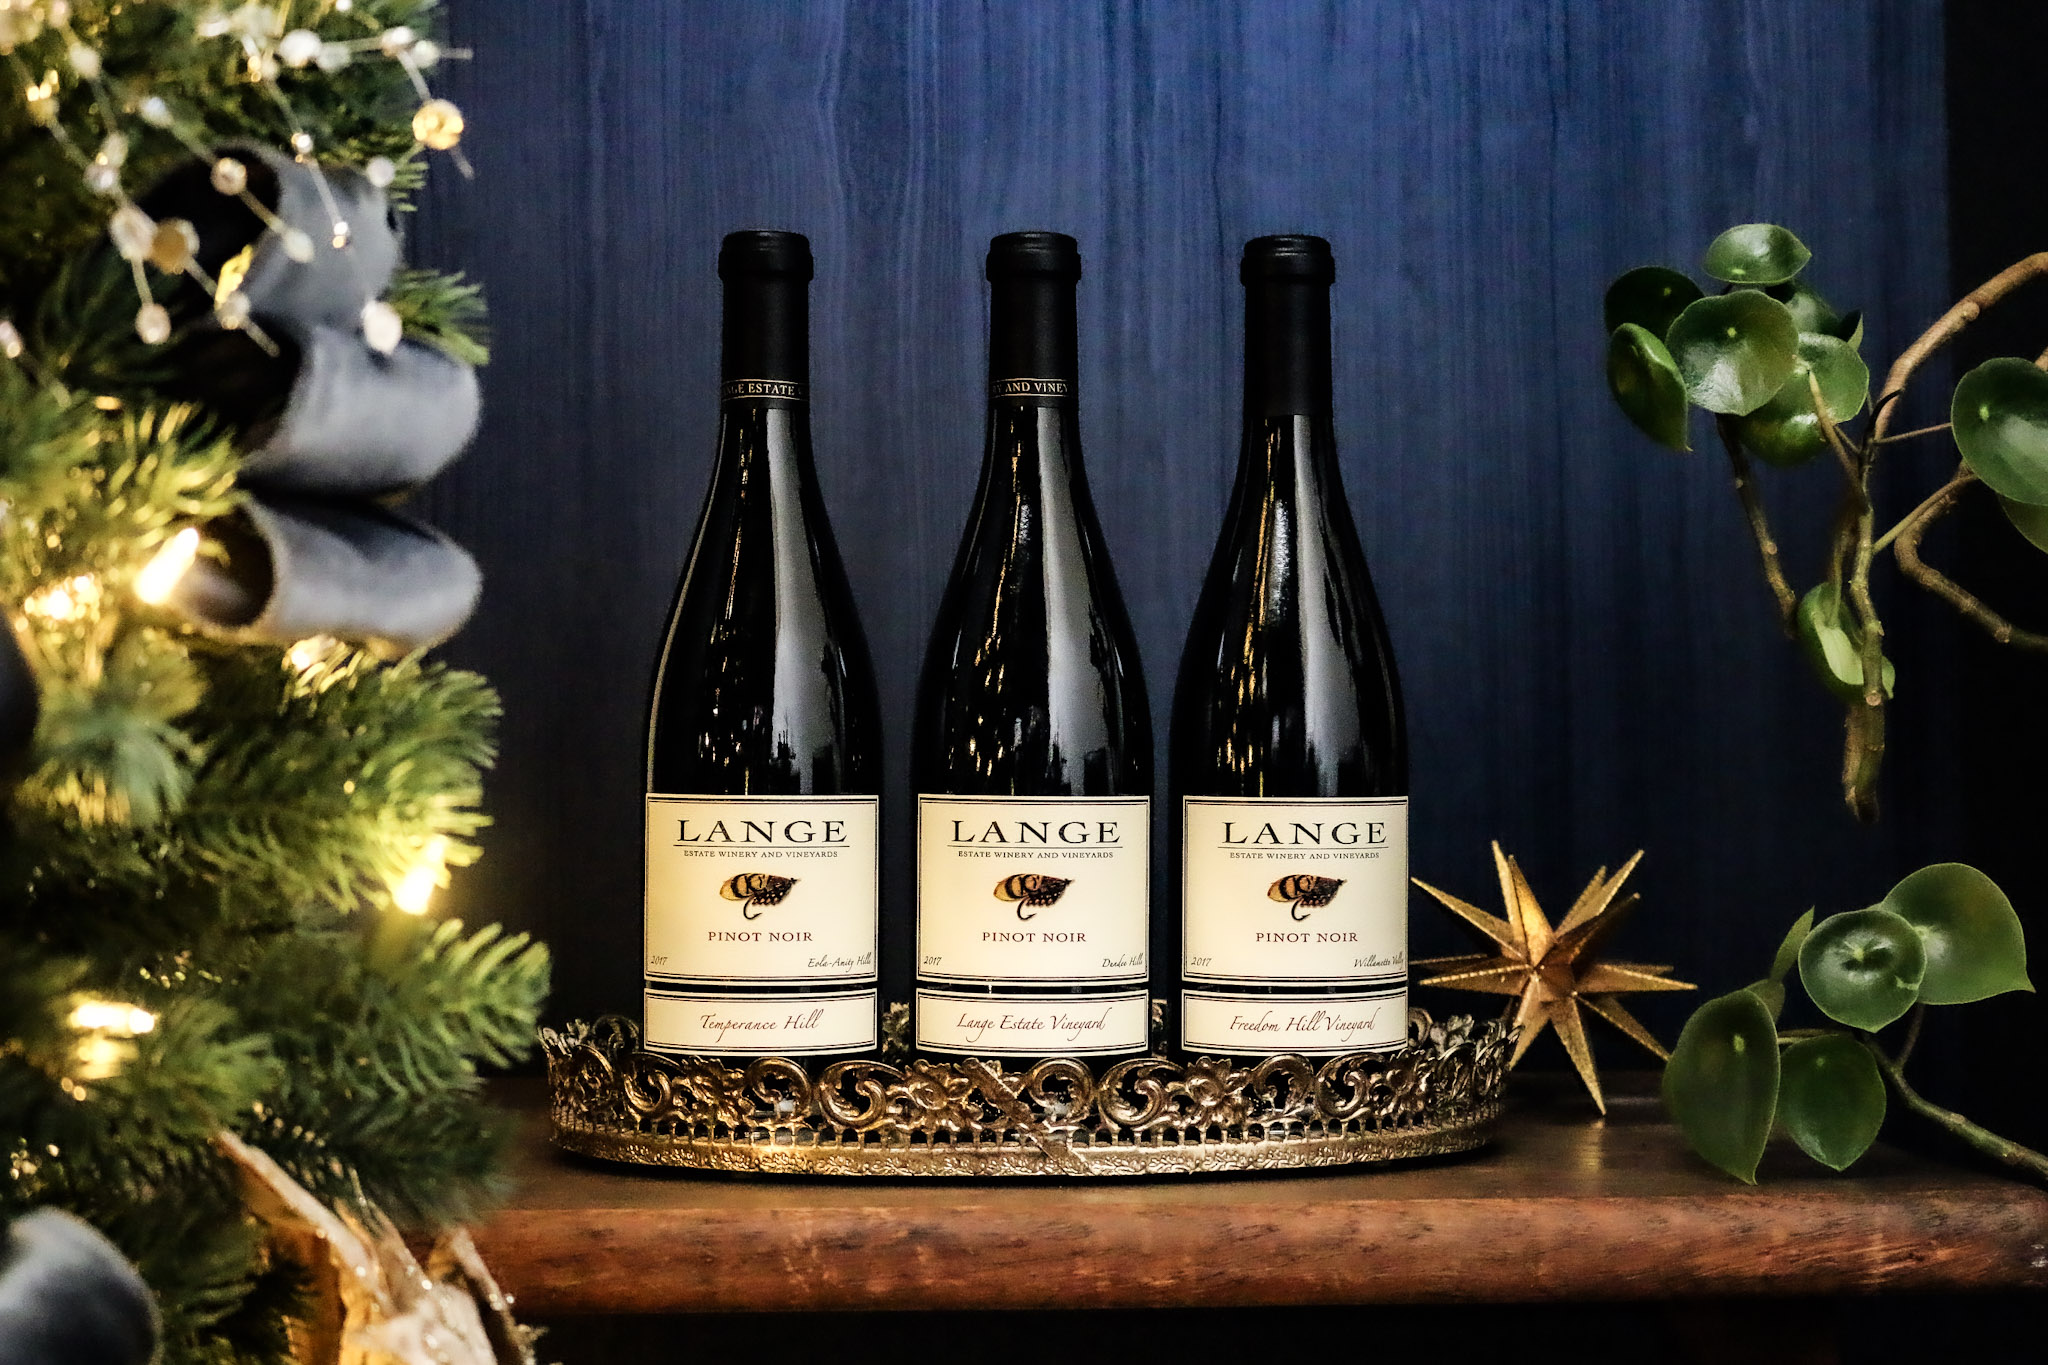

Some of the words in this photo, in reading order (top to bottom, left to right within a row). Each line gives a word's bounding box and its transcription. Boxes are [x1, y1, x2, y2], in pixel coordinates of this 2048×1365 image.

[748, 383, 795, 396] ESTATE
[1005, 381, 1031, 393] AND
[677, 819, 848, 844] LANGE
[951, 820, 1121, 844] LANGE
[1221, 821, 1388, 845] LANGE
[683, 850, 716, 858] ESTATE
[958, 850, 991, 858] ESTATE
[994, 851, 1033, 859] WINERY
[1037, 851, 1059, 859] AND
[1061, 851, 1114, 859] VINEYARDS
[1266, 852, 1306, 860] WINERY
[1309, 852, 1331, 860] AND
[708, 931, 762, 942] PINOT
[769, 932, 814, 942] NOIR
[982, 932, 1036, 942] PINOT
[1042, 932, 1087, 942] NOIR
[1256, 932, 1311, 943] PINOT
[1317, 932, 1359, 943] NOIR
[650, 955, 668, 966] 2017
[923, 955, 942, 966] 2017
[1190, 956, 1212, 967] 2017
[699, 1013, 777, 1043] Temperance
[783, 1008, 825, 1030] Hill
[956, 1012, 995, 1043] Lange
[999, 1014, 1046, 1031] Estate
[1049, 1007, 1113, 1042] Vineyard
[1229, 1010, 1281, 1033] Freedom
[1285, 1010, 1327, 1033] Hill
[1325, 1007, 1382, 1043] Vineyard
